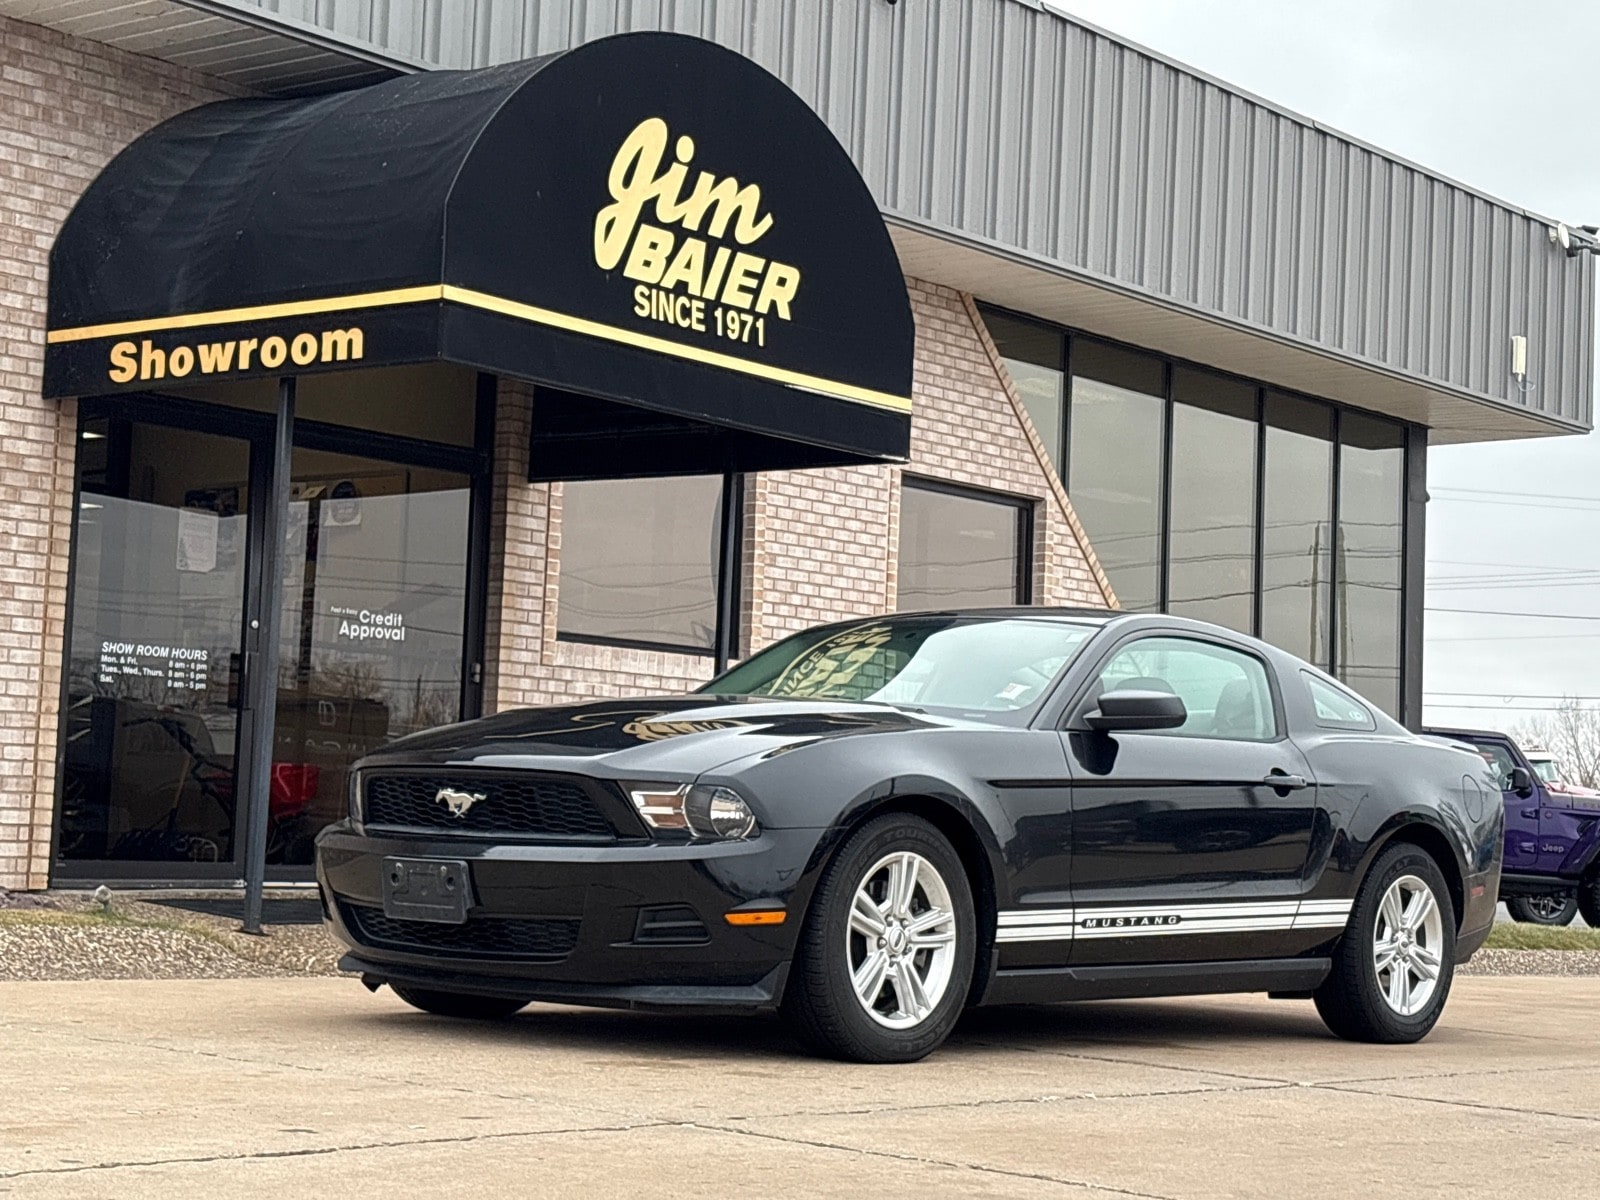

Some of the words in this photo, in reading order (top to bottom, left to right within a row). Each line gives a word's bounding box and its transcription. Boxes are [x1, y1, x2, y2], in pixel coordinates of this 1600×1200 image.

[594, 118, 774, 270] Jim
[623, 223, 800, 321] BAIER
[634, 285, 706, 332] SINCE
[714, 307, 765, 347] 1971
[108, 328, 364, 384] Showroom
[359, 610, 403, 627] Credit
[339, 620, 405, 641] Approval
[101, 654, 118, 663] Mon.
[102, 641, 135, 655] SHOW
[136, 644, 170, 658] ROOM
[171, 648, 208, 661] HOURS
[100, 674, 114, 683] Sat.
[1542, 843, 1564, 853] Jeep
[1086, 916, 1177, 928] MUSTANG
